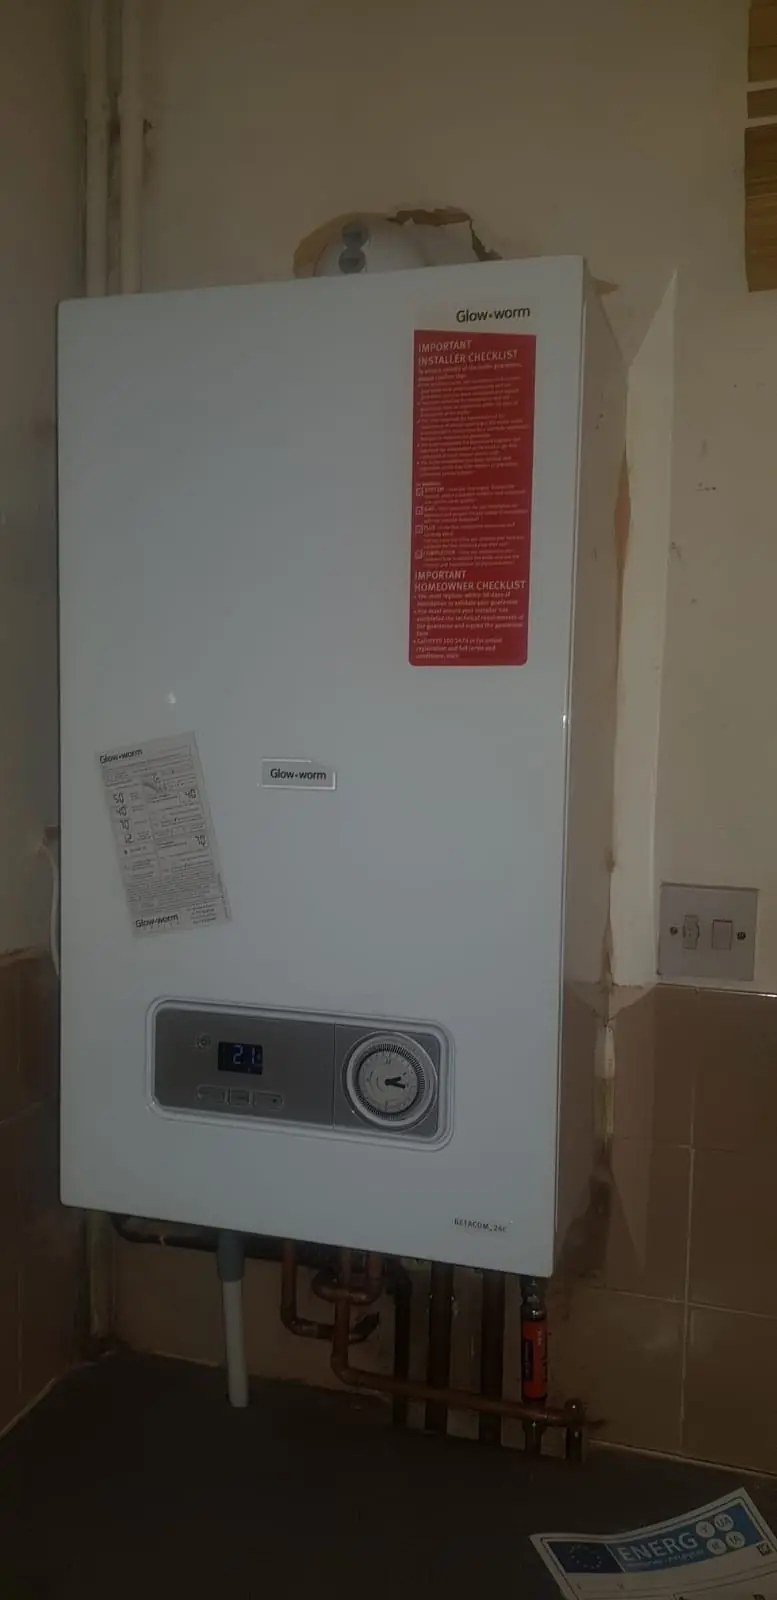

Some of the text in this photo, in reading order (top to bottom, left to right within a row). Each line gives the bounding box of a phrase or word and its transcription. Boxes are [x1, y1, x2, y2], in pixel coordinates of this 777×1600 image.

[418, 340, 472, 352] IMPORTANT
[418, 348, 518, 367] INSTALLER CHECKLIST
[415, 570, 466, 580] IMPORTANT
[414, 580, 526, 592] HOMEOWNER CHECKLIST
[618, 1532, 698, 1561] ENERG
